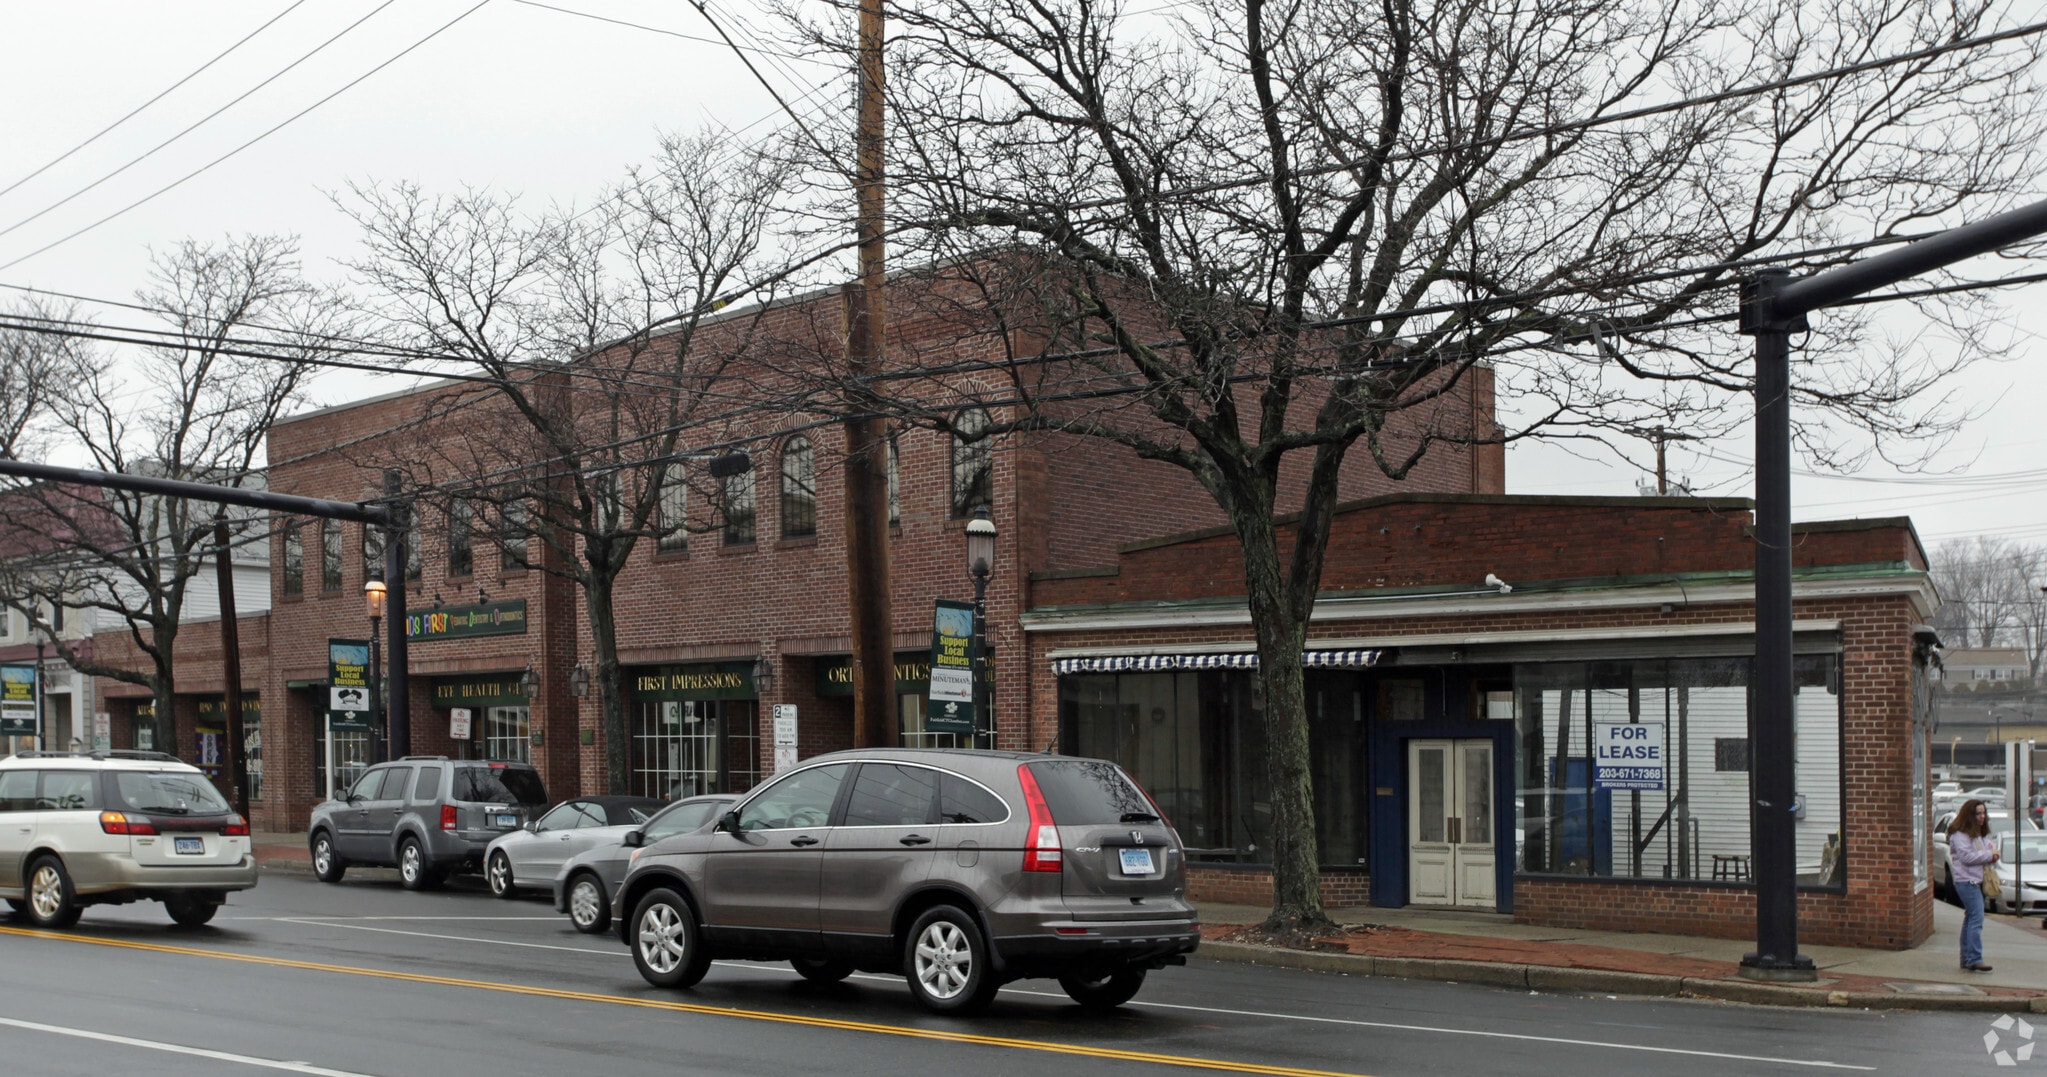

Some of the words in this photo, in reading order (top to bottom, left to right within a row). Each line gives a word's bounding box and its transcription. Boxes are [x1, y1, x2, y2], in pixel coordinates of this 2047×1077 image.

[406, 616, 420, 636] IDS
[424, 612, 448, 634] FIRST
[940, 636, 968, 647] Support
[944, 645, 964, 656] Local
[937, 654, 969, 666] Business
[336, 664, 363, 672] Support
[340, 671, 359, 679] Local
[334, 677, 365, 685] Business
[638, 675, 667, 691] FIRST
[672, 673, 742, 689] IMPRESSIONS
[437, 685, 454, 698] EYE
[462, 683, 500, 697] HEALTH
[775, 706, 781, 717] 2
[1611, 727, 1647, 740] FOR
[1599, 745, 1659, 759] LEASE
[1599, 768, 1660, 779] 203-671-7368
